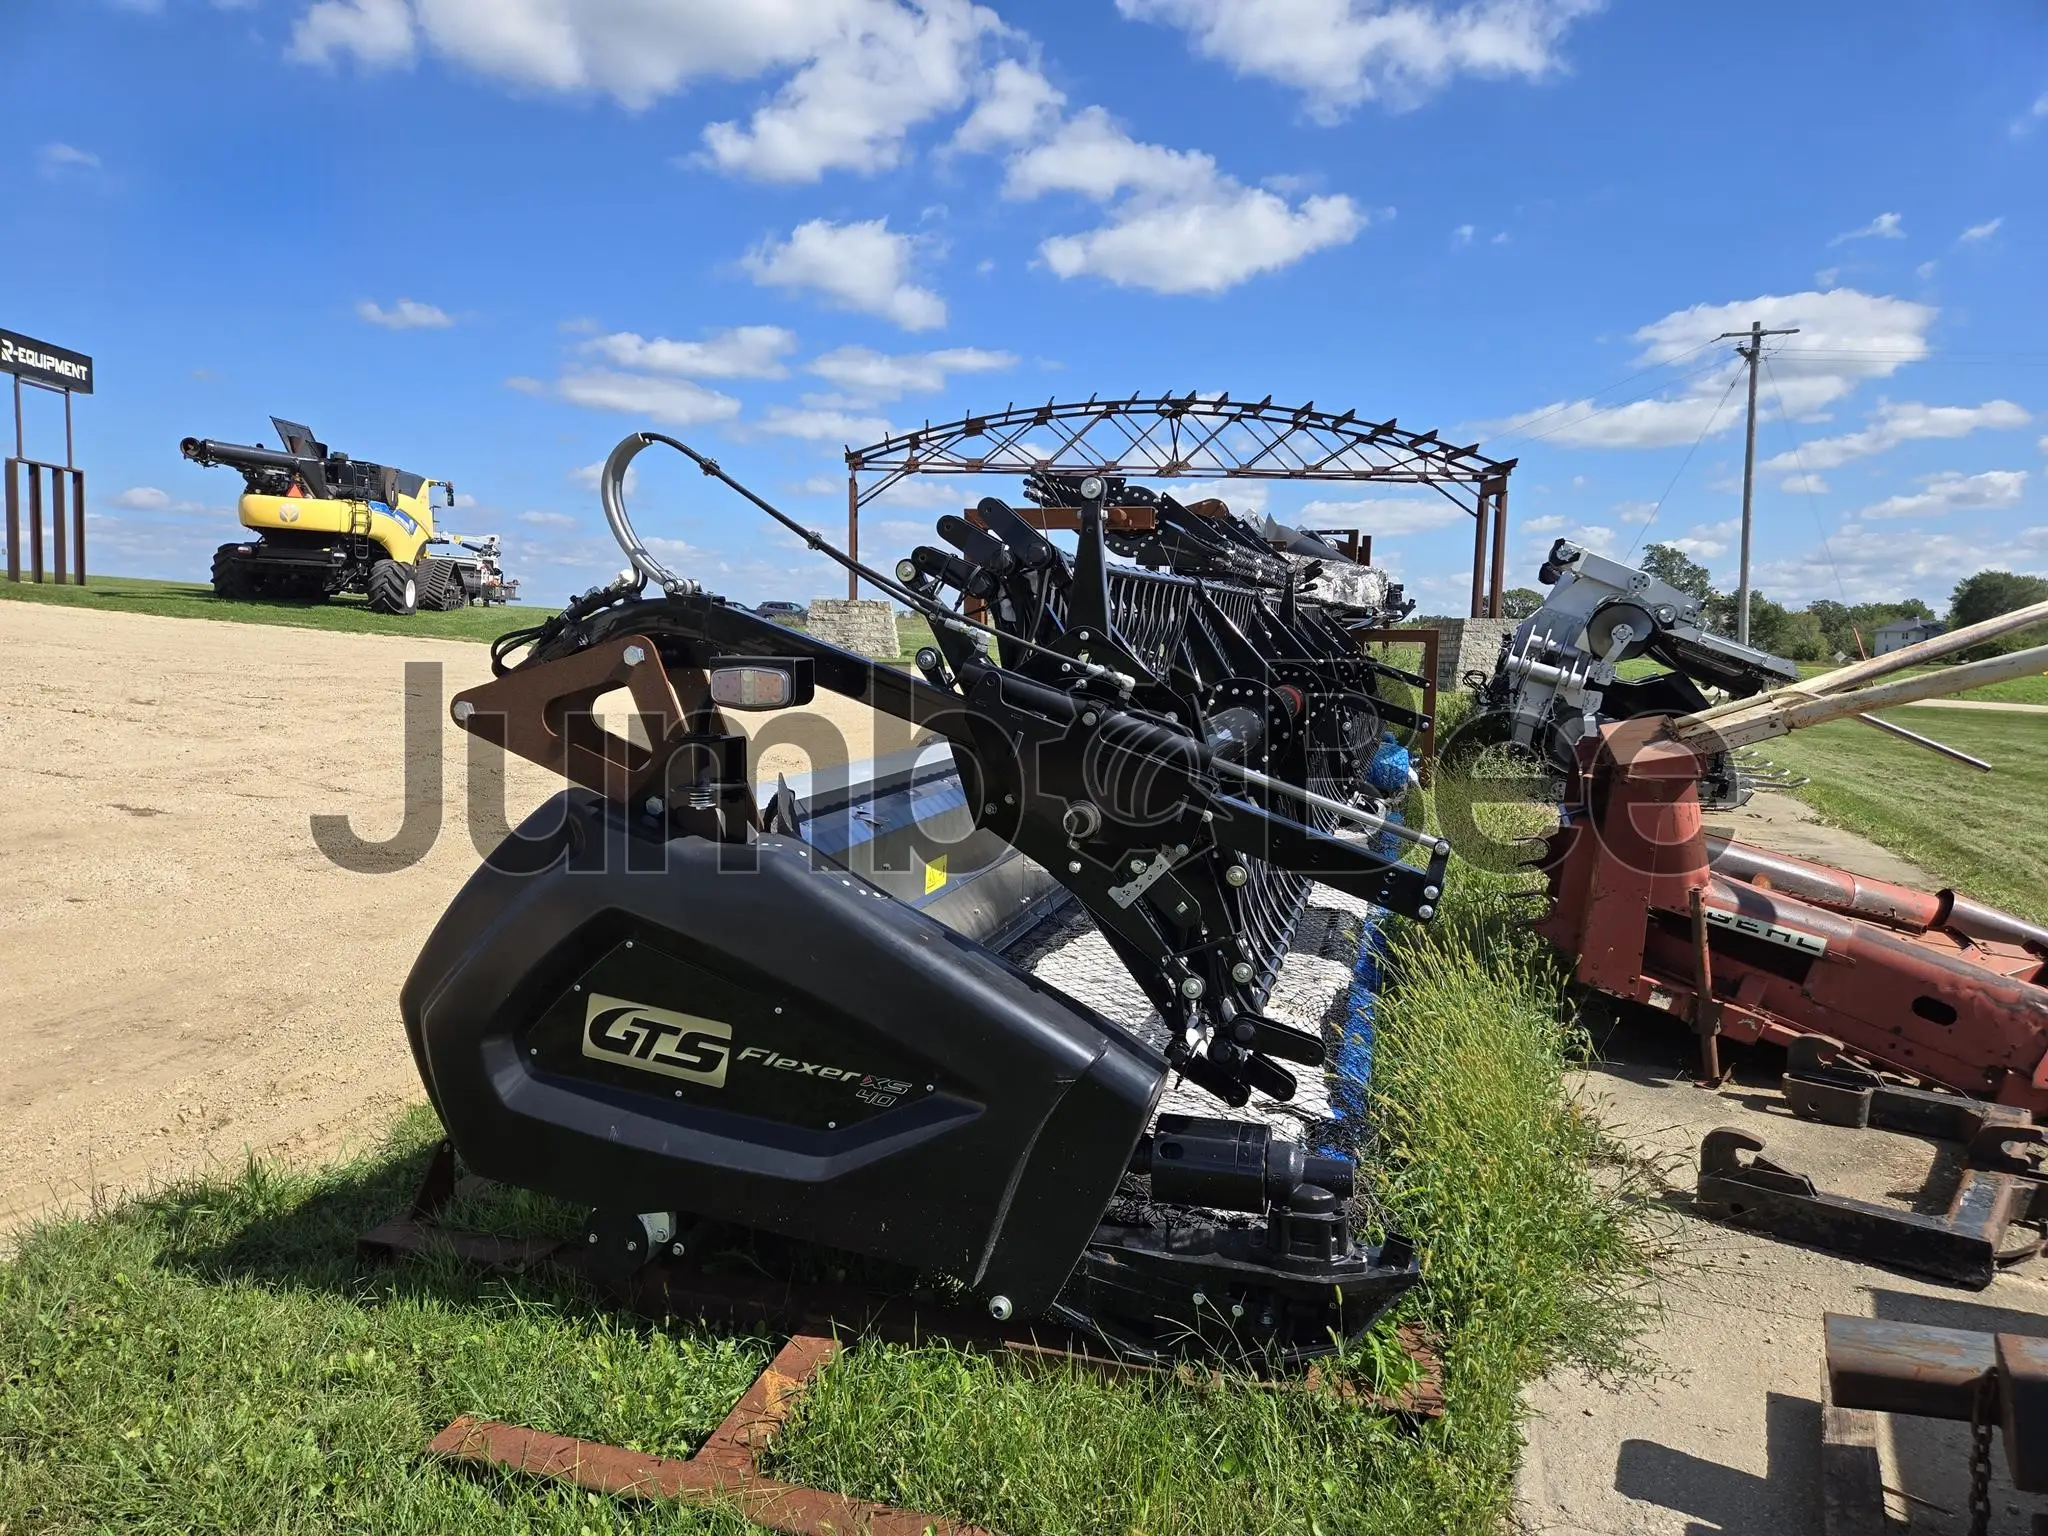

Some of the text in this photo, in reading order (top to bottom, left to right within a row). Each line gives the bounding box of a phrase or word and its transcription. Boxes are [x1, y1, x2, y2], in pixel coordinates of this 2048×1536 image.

[588, 1006, 913, 1095] GTS Flexer XS
[855, 1089, 898, 1108] 40
